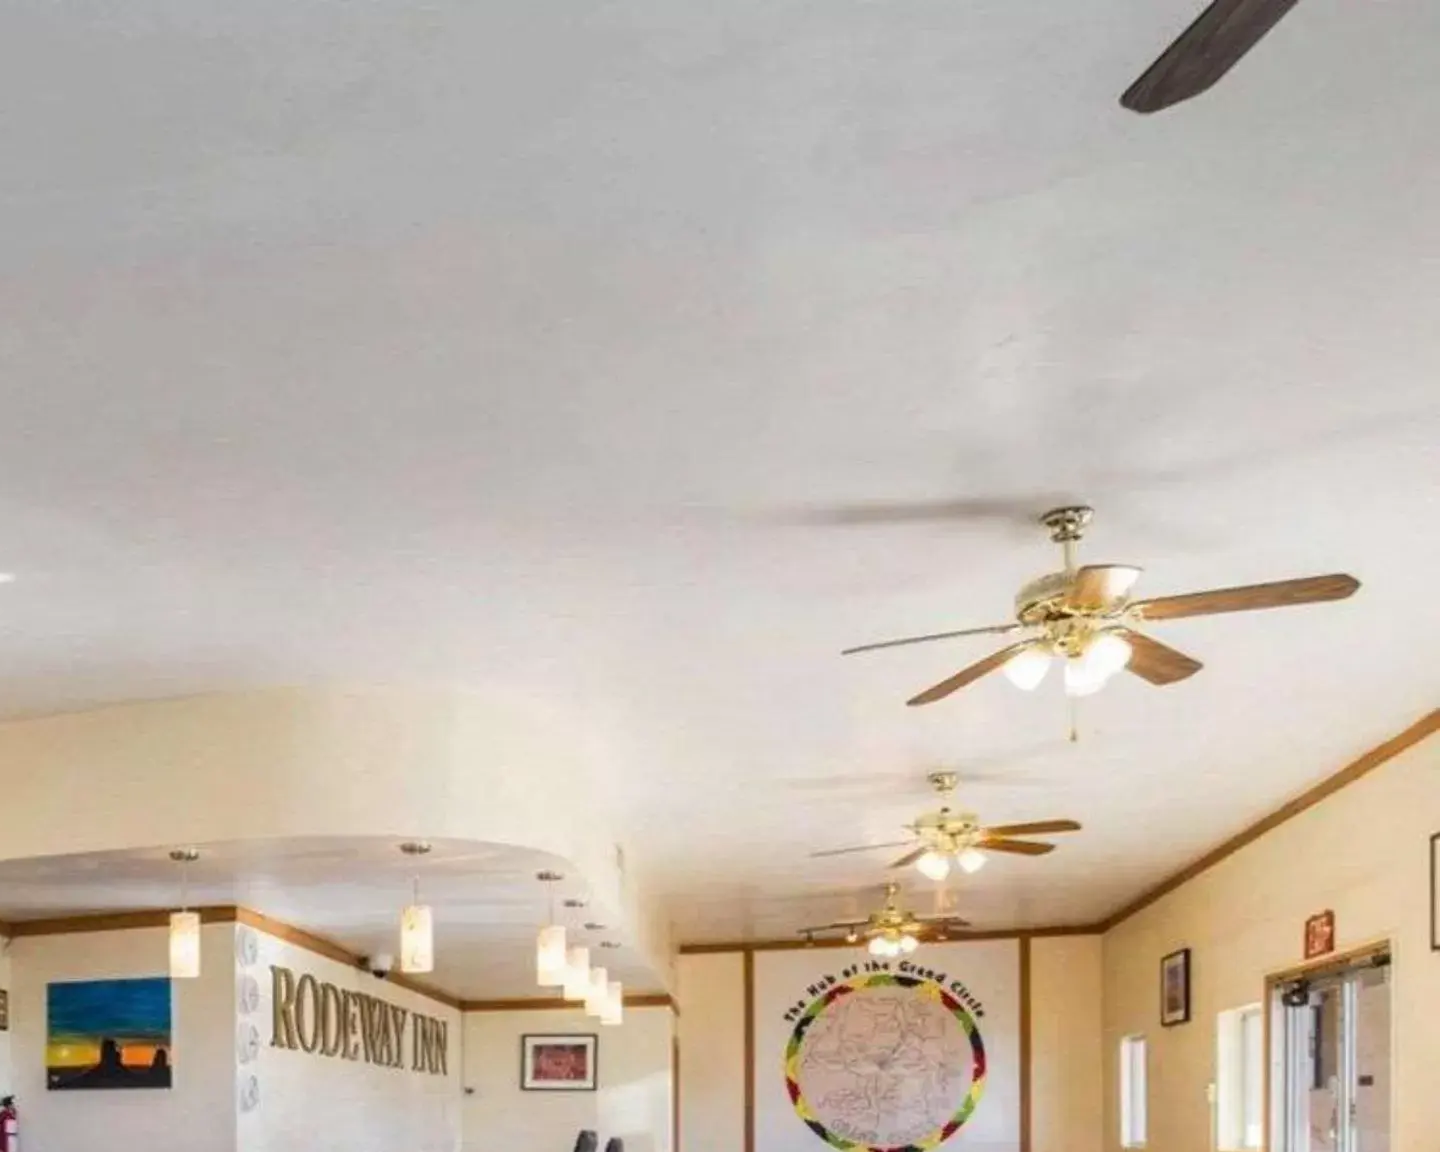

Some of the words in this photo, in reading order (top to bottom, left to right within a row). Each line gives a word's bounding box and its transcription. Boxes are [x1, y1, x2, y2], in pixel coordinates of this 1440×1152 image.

[270, 964, 408, 1070] RODEWAY
[411, 1012, 448, 1076] INN
[783, 1000, 806, 1021] The
[806, 975, 836, 997] Hub
[843, 963, 858, 978] of
[898, 960, 947, 984] Grand
[951, 981, 984, 1017] Circle
